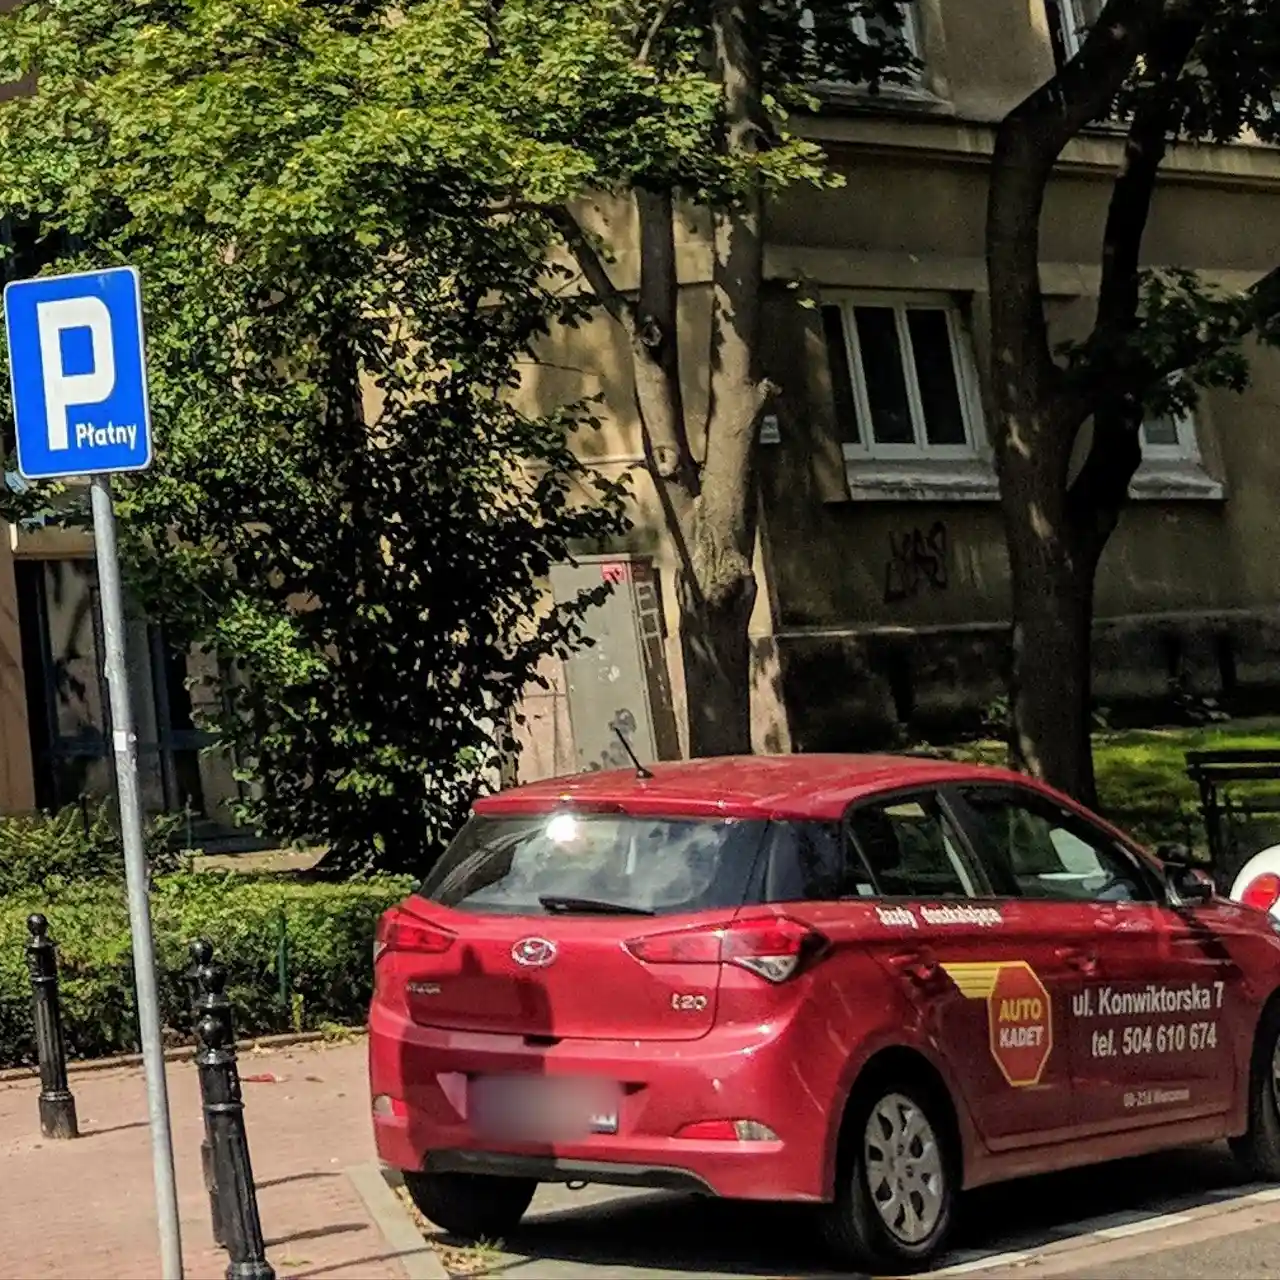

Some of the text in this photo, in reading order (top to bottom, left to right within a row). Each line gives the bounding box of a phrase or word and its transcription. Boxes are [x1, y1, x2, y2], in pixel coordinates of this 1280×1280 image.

[36, 296, 115, 451] P
[75, 420, 137, 450] Płatny
[999, 997, 1042, 1022] AUTO
[1072, 981, 1225, 1017] ul. Konwiktorska 7
[999, 1025, 1044, 1048] KADET
[1091, 1021, 1218, 1057] tel. 504 610 674
